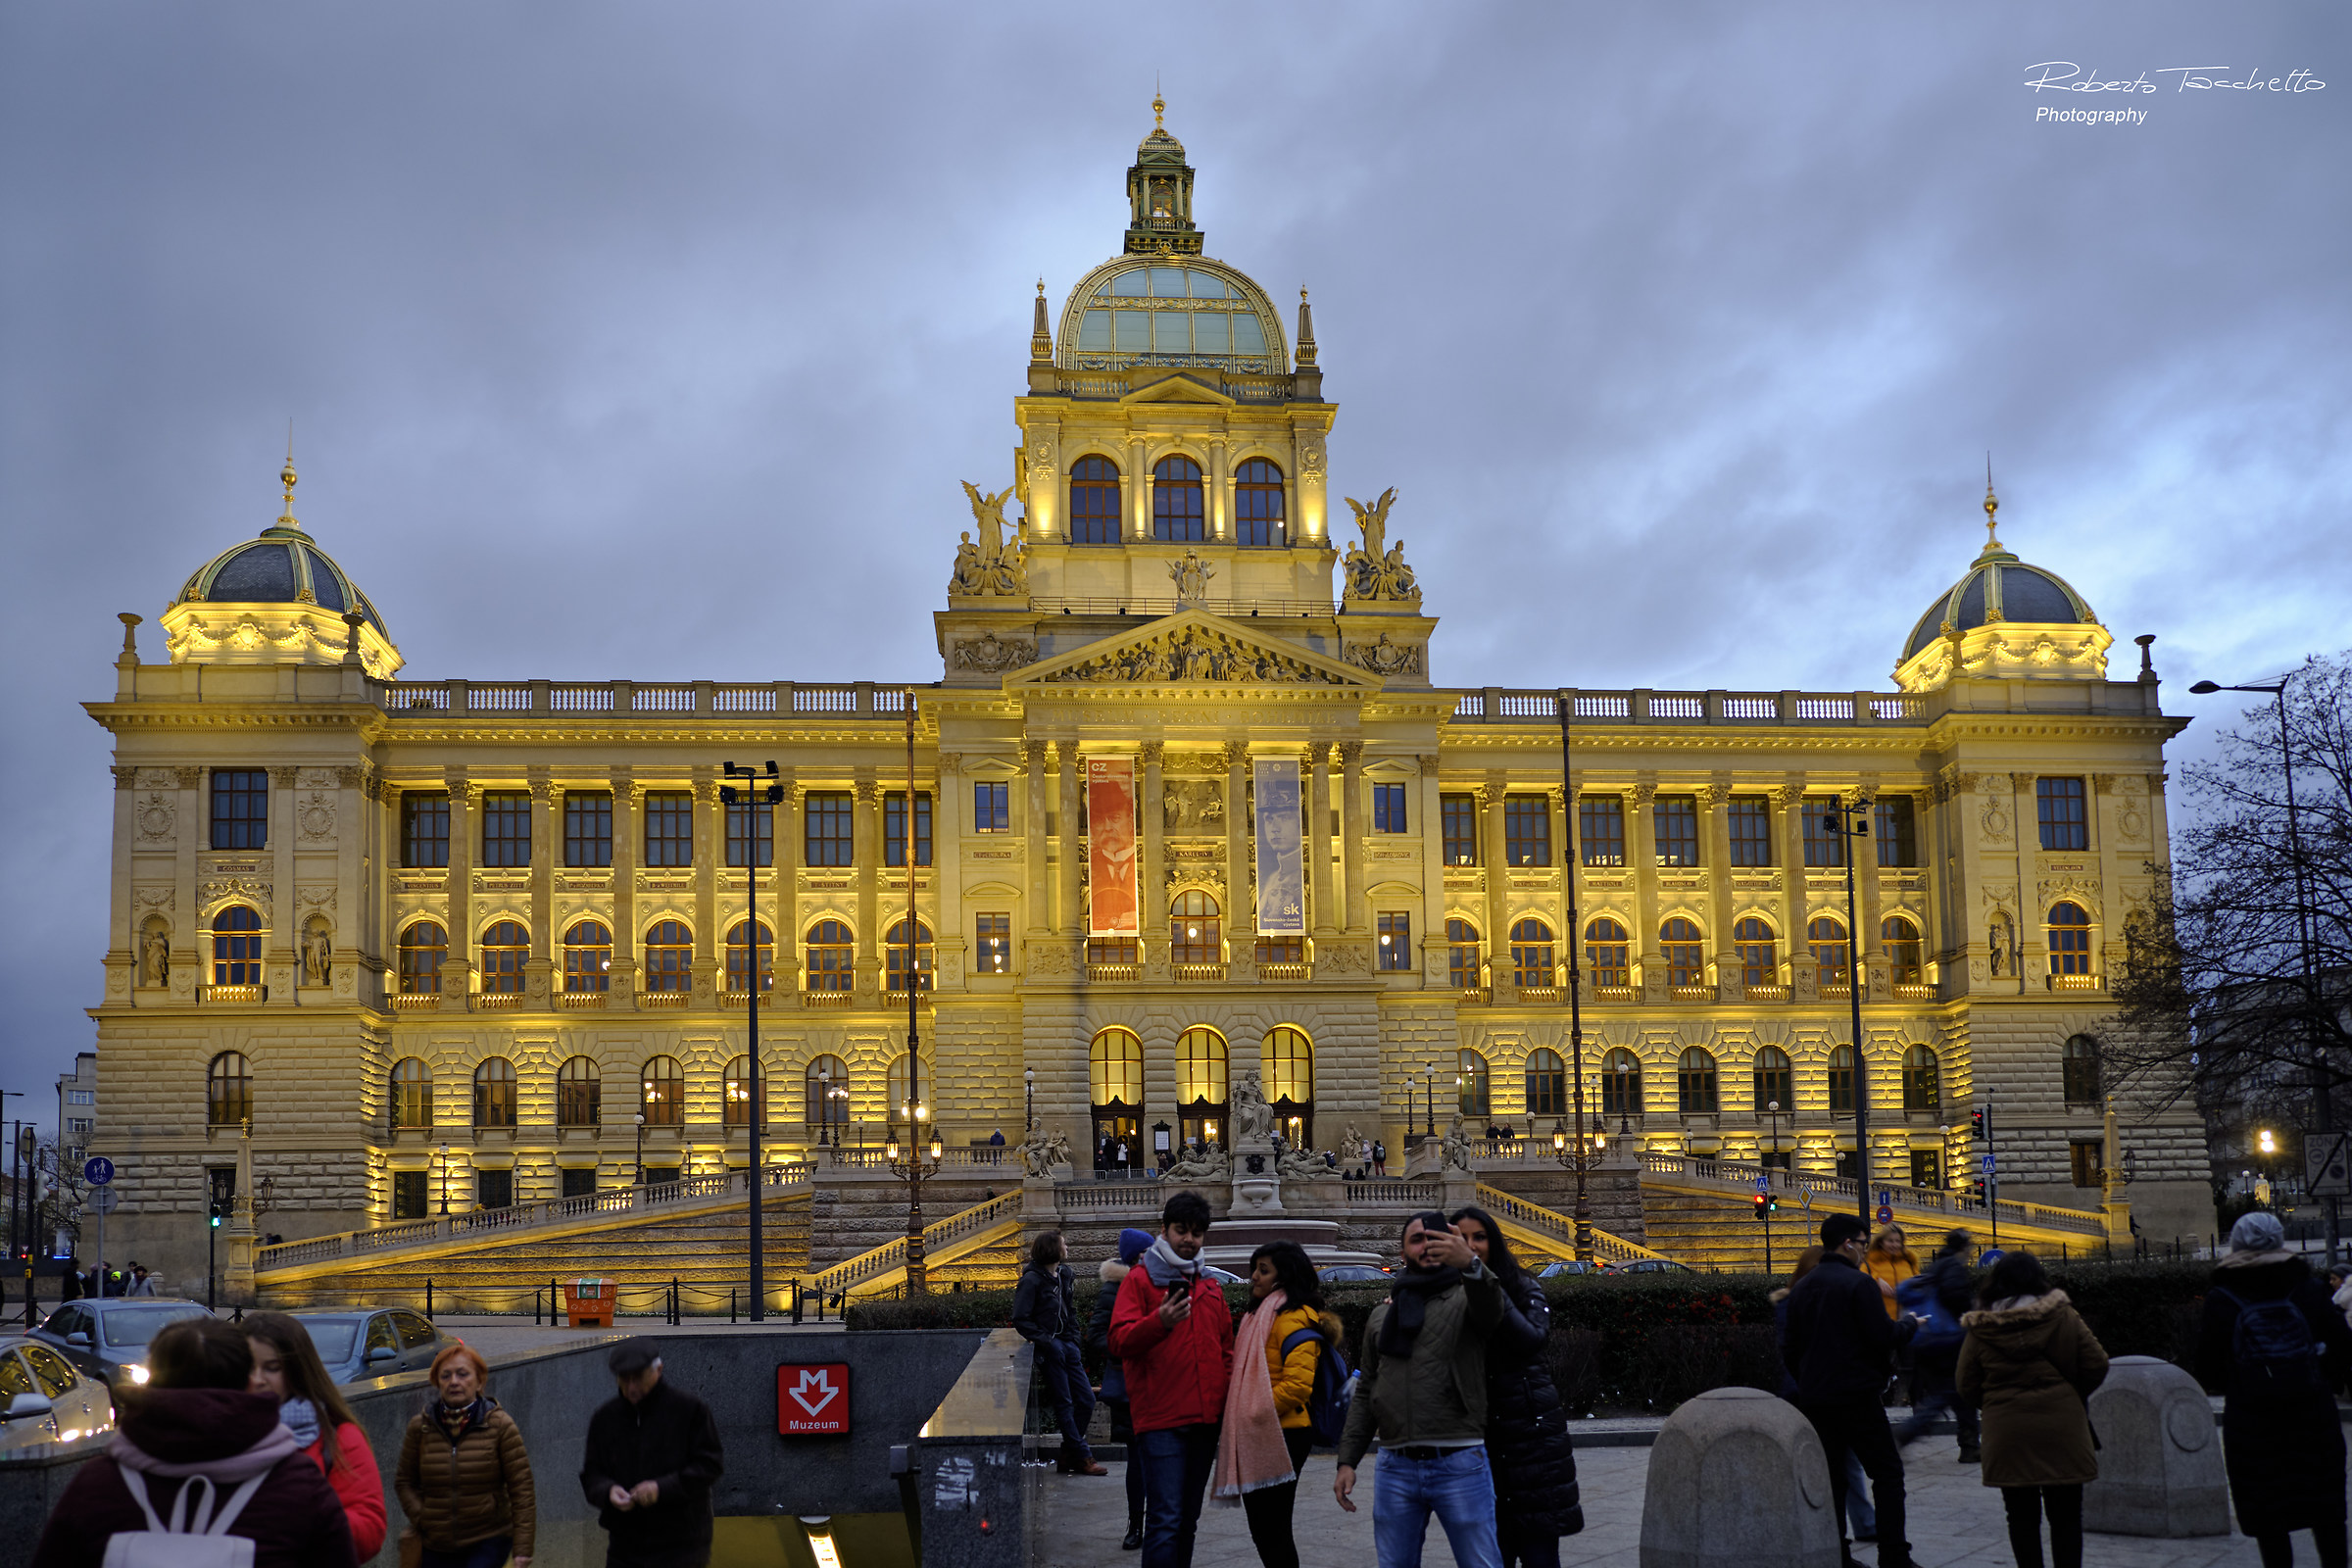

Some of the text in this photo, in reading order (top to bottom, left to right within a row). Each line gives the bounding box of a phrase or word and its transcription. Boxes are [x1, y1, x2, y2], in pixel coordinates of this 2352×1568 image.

[1053, 709, 1134, 722] MUSEUM
[1157, 710, 1218, 723] REGNI
[1283, 903, 1300, 915] sk
[789, 1420, 840, 1430] Muzeum
